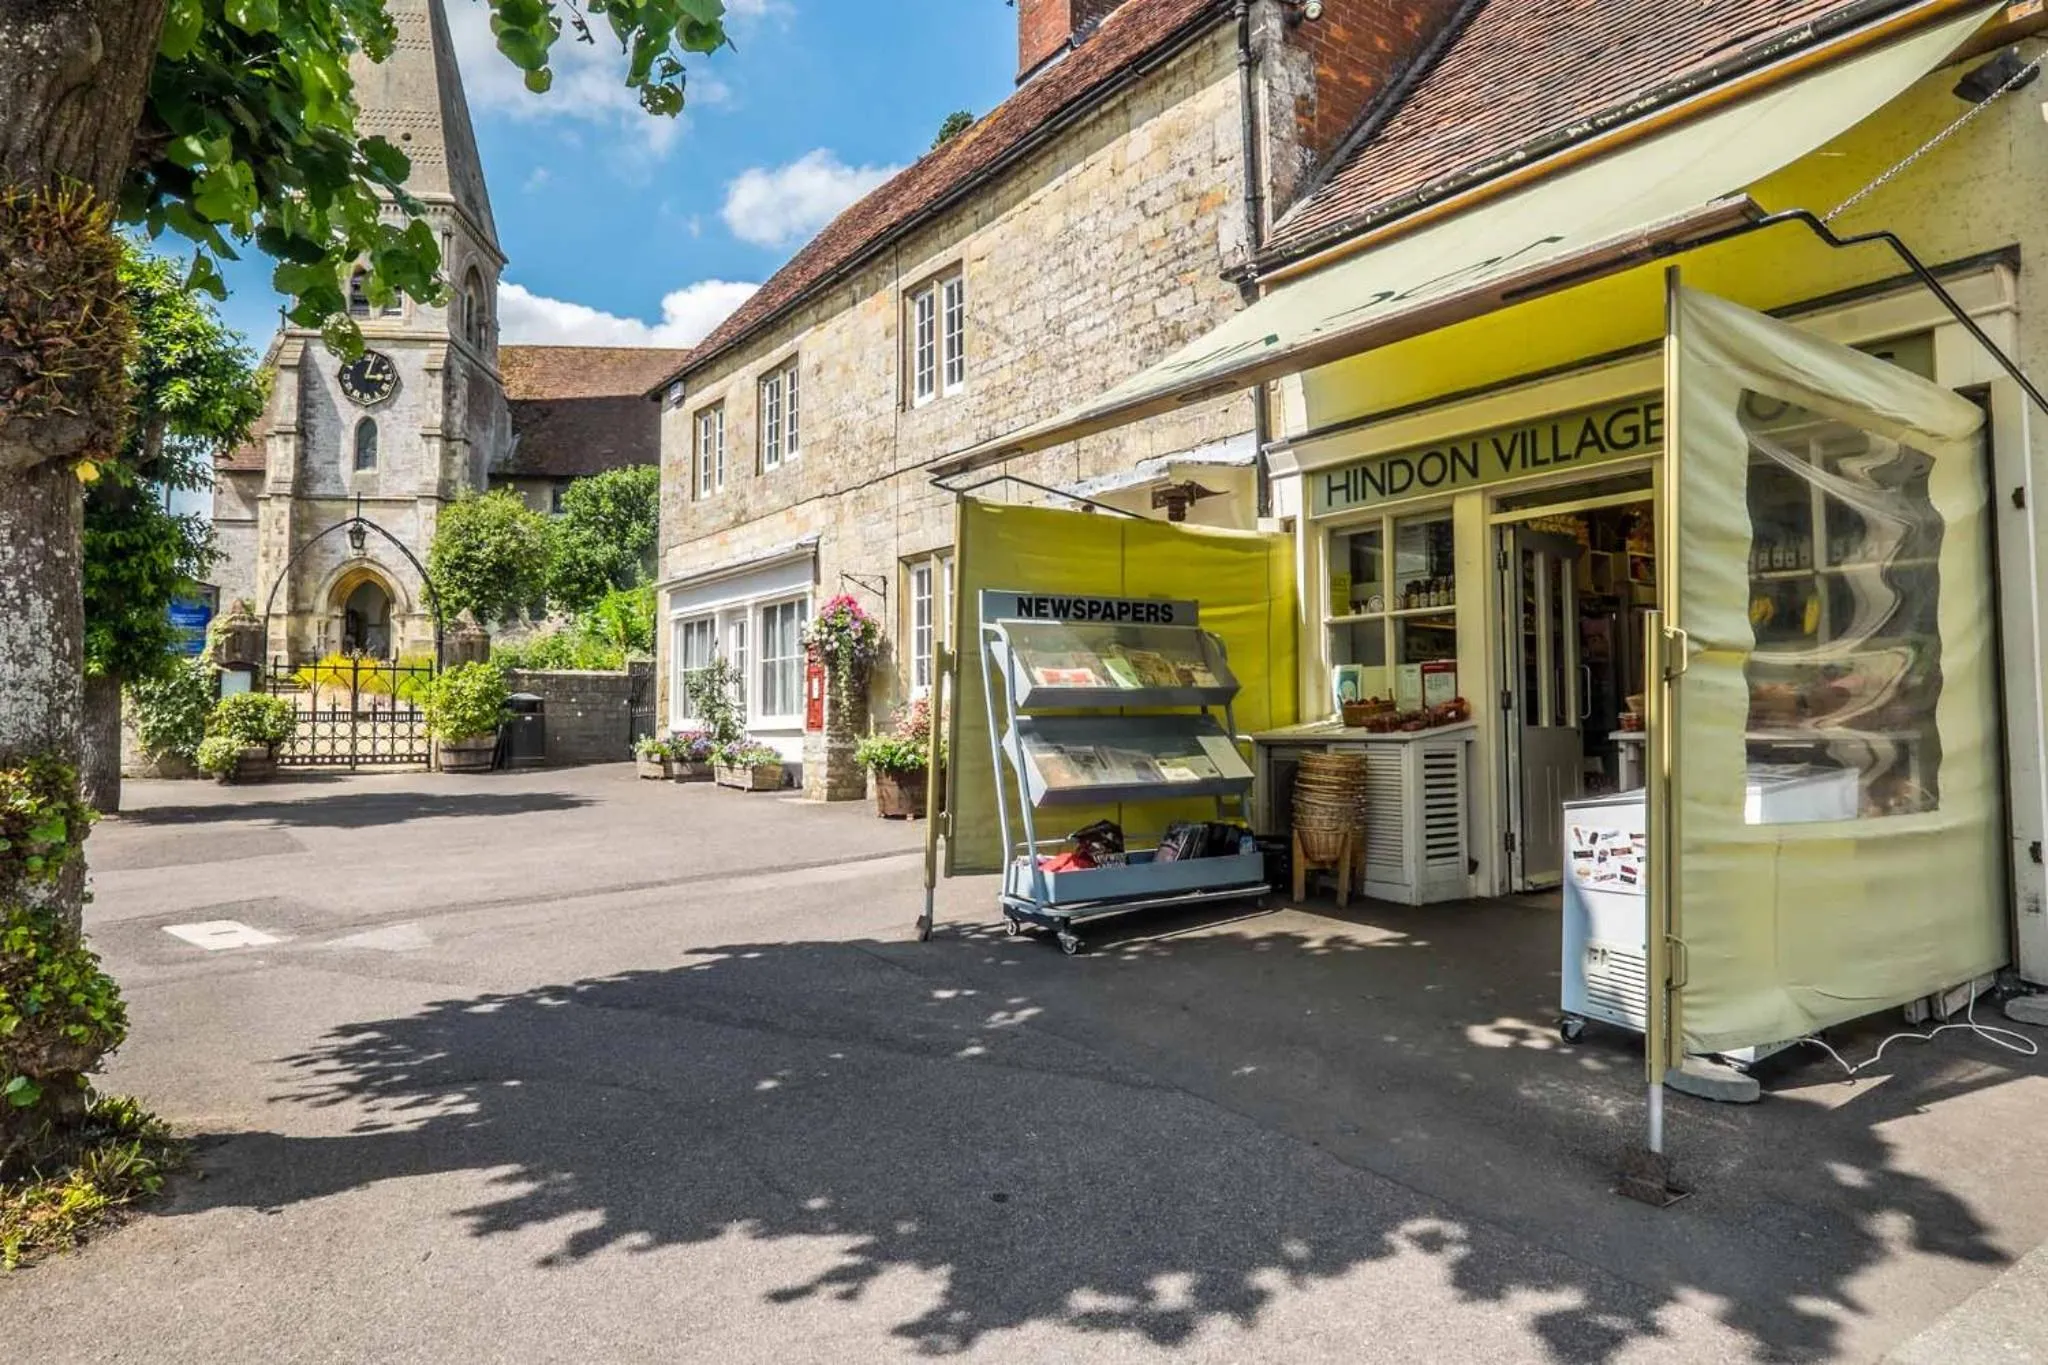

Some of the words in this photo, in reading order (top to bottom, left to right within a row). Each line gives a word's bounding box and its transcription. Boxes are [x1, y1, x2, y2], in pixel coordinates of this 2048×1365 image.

[1327, 442, 1480, 507] HINDON
[1491, 402, 1665, 473] VILLAGE
[1017, 597, 1174, 623] NEWSPAPERS
